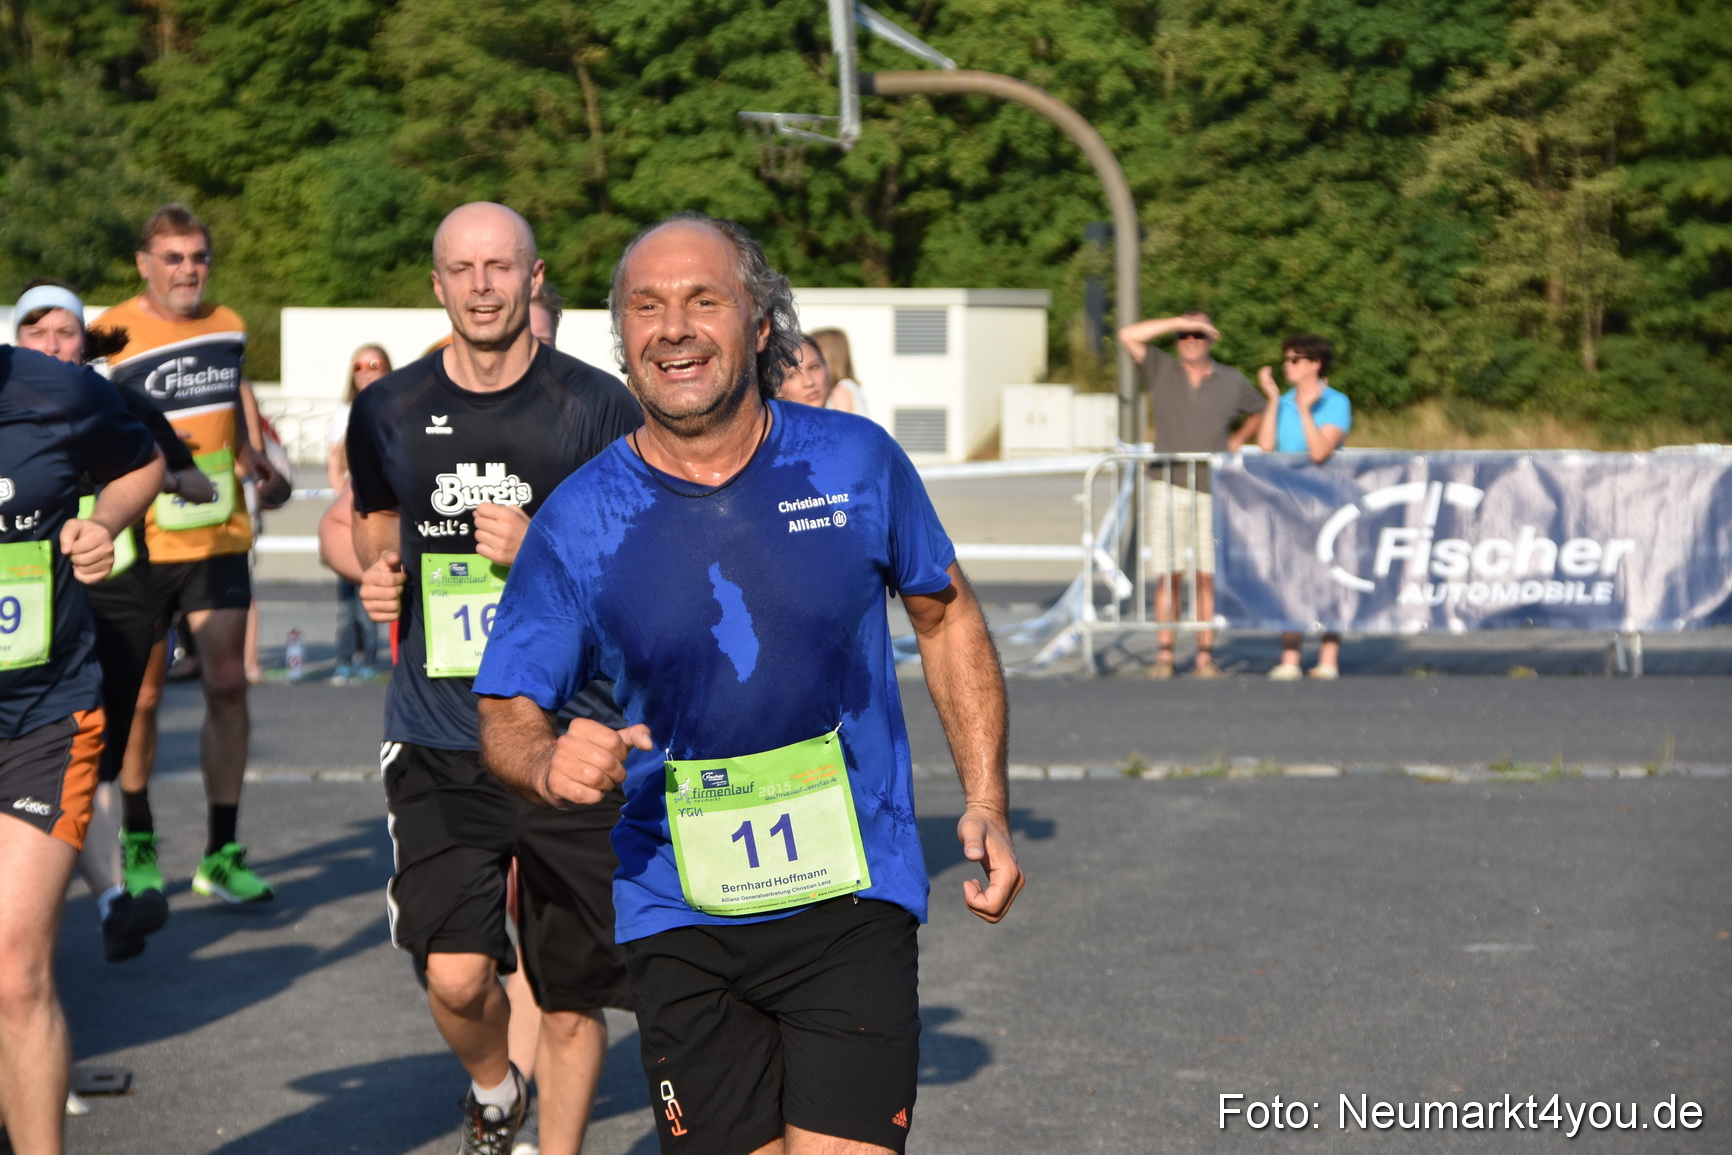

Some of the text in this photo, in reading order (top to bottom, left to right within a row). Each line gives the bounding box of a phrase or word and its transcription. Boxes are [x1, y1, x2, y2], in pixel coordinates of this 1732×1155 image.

[165, 364, 238, 391] Fischer
[431, 473, 533, 517] Burgis
[779, 493, 849, 513] Christian Lenz
[789, 517, 831, 533] Allianz
[1372, 524, 1637, 580] Fischer
[441, 573, 488, 585] firmenlauf
[1397, 580, 1616, 607] AUTOMOBILE
[692, 780, 791, 800] firmenlauf 2015
[730, 813, 799, 869] 11
[720, 878, 832, 903] Allianz Generalvertretung Christian Lenz
[721, 868, 828, 894] Bernhard Hoffmann
